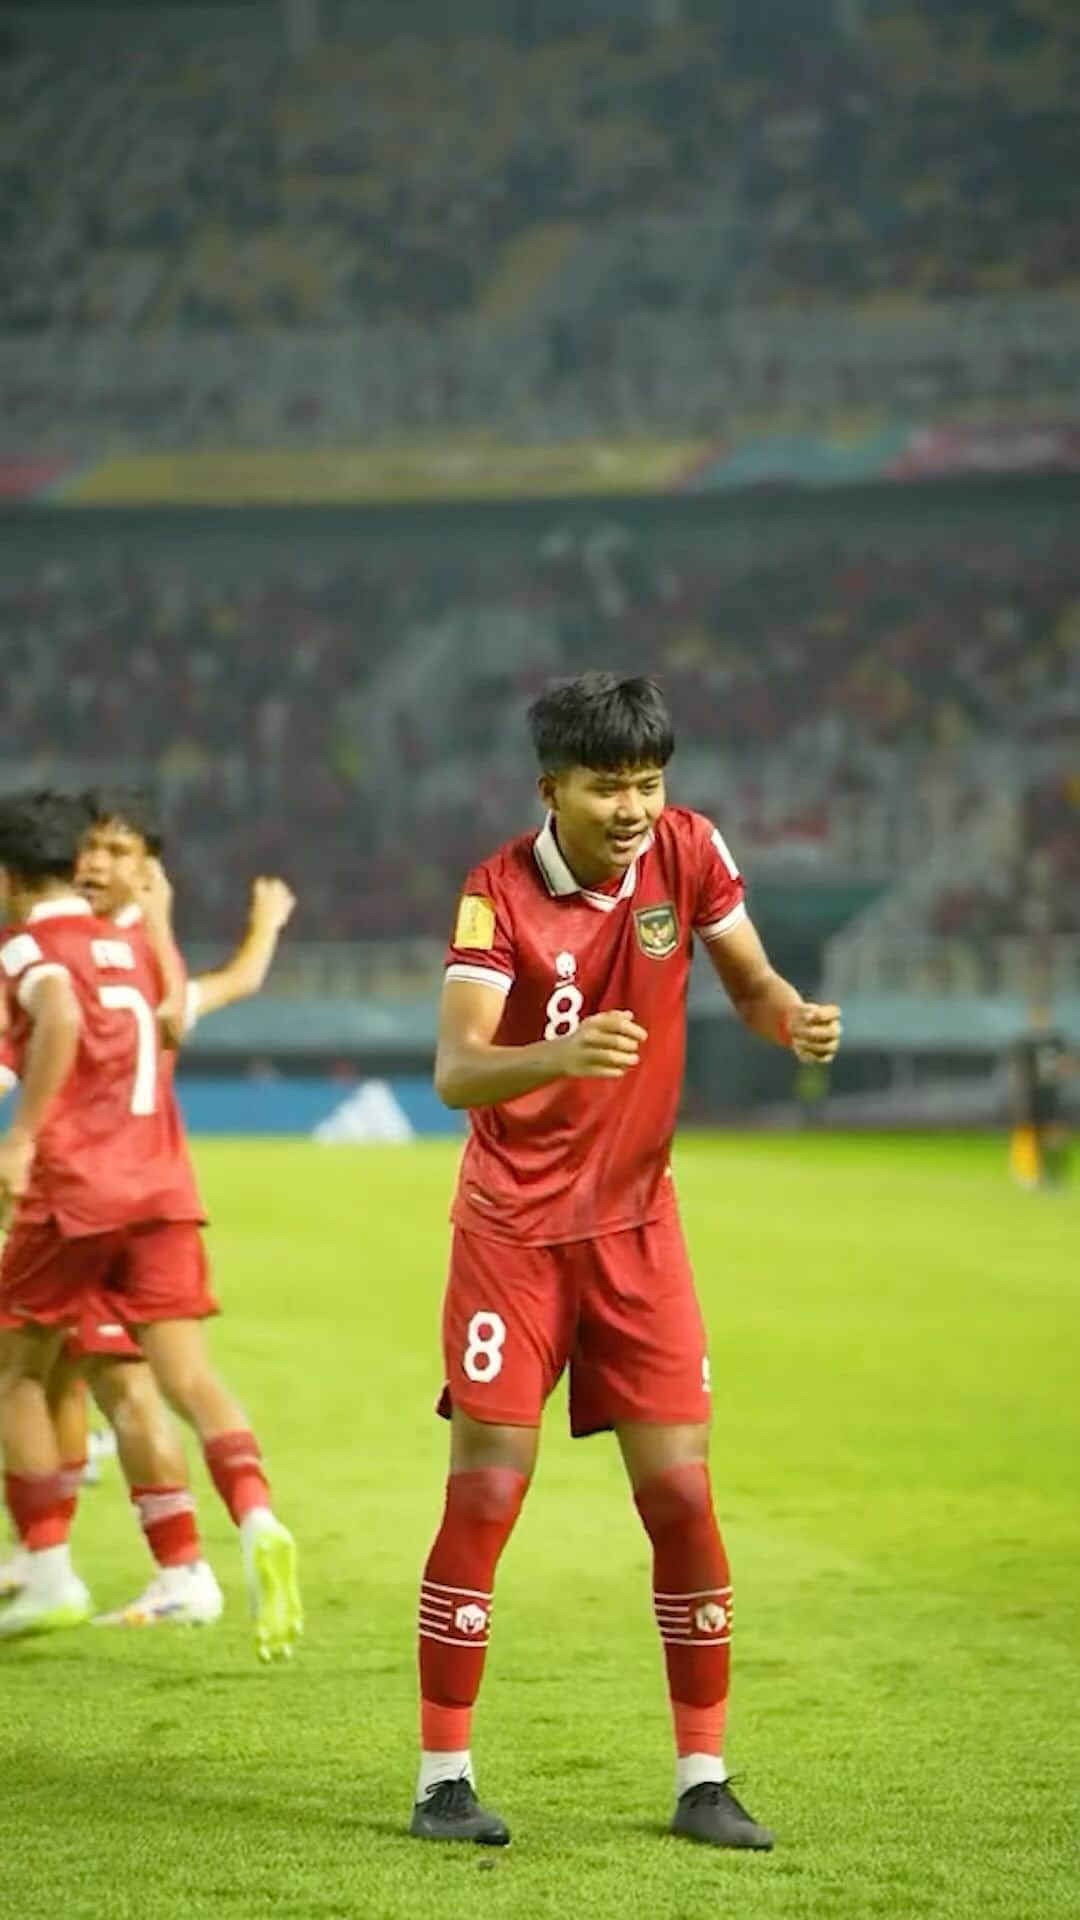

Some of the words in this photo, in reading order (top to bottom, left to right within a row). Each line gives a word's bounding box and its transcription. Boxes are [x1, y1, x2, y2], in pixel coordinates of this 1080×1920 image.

[544, 985, 584, 1041] 8
[98, 985, 156, 1115] 7
[463, 1311, 506, 1383] 8
